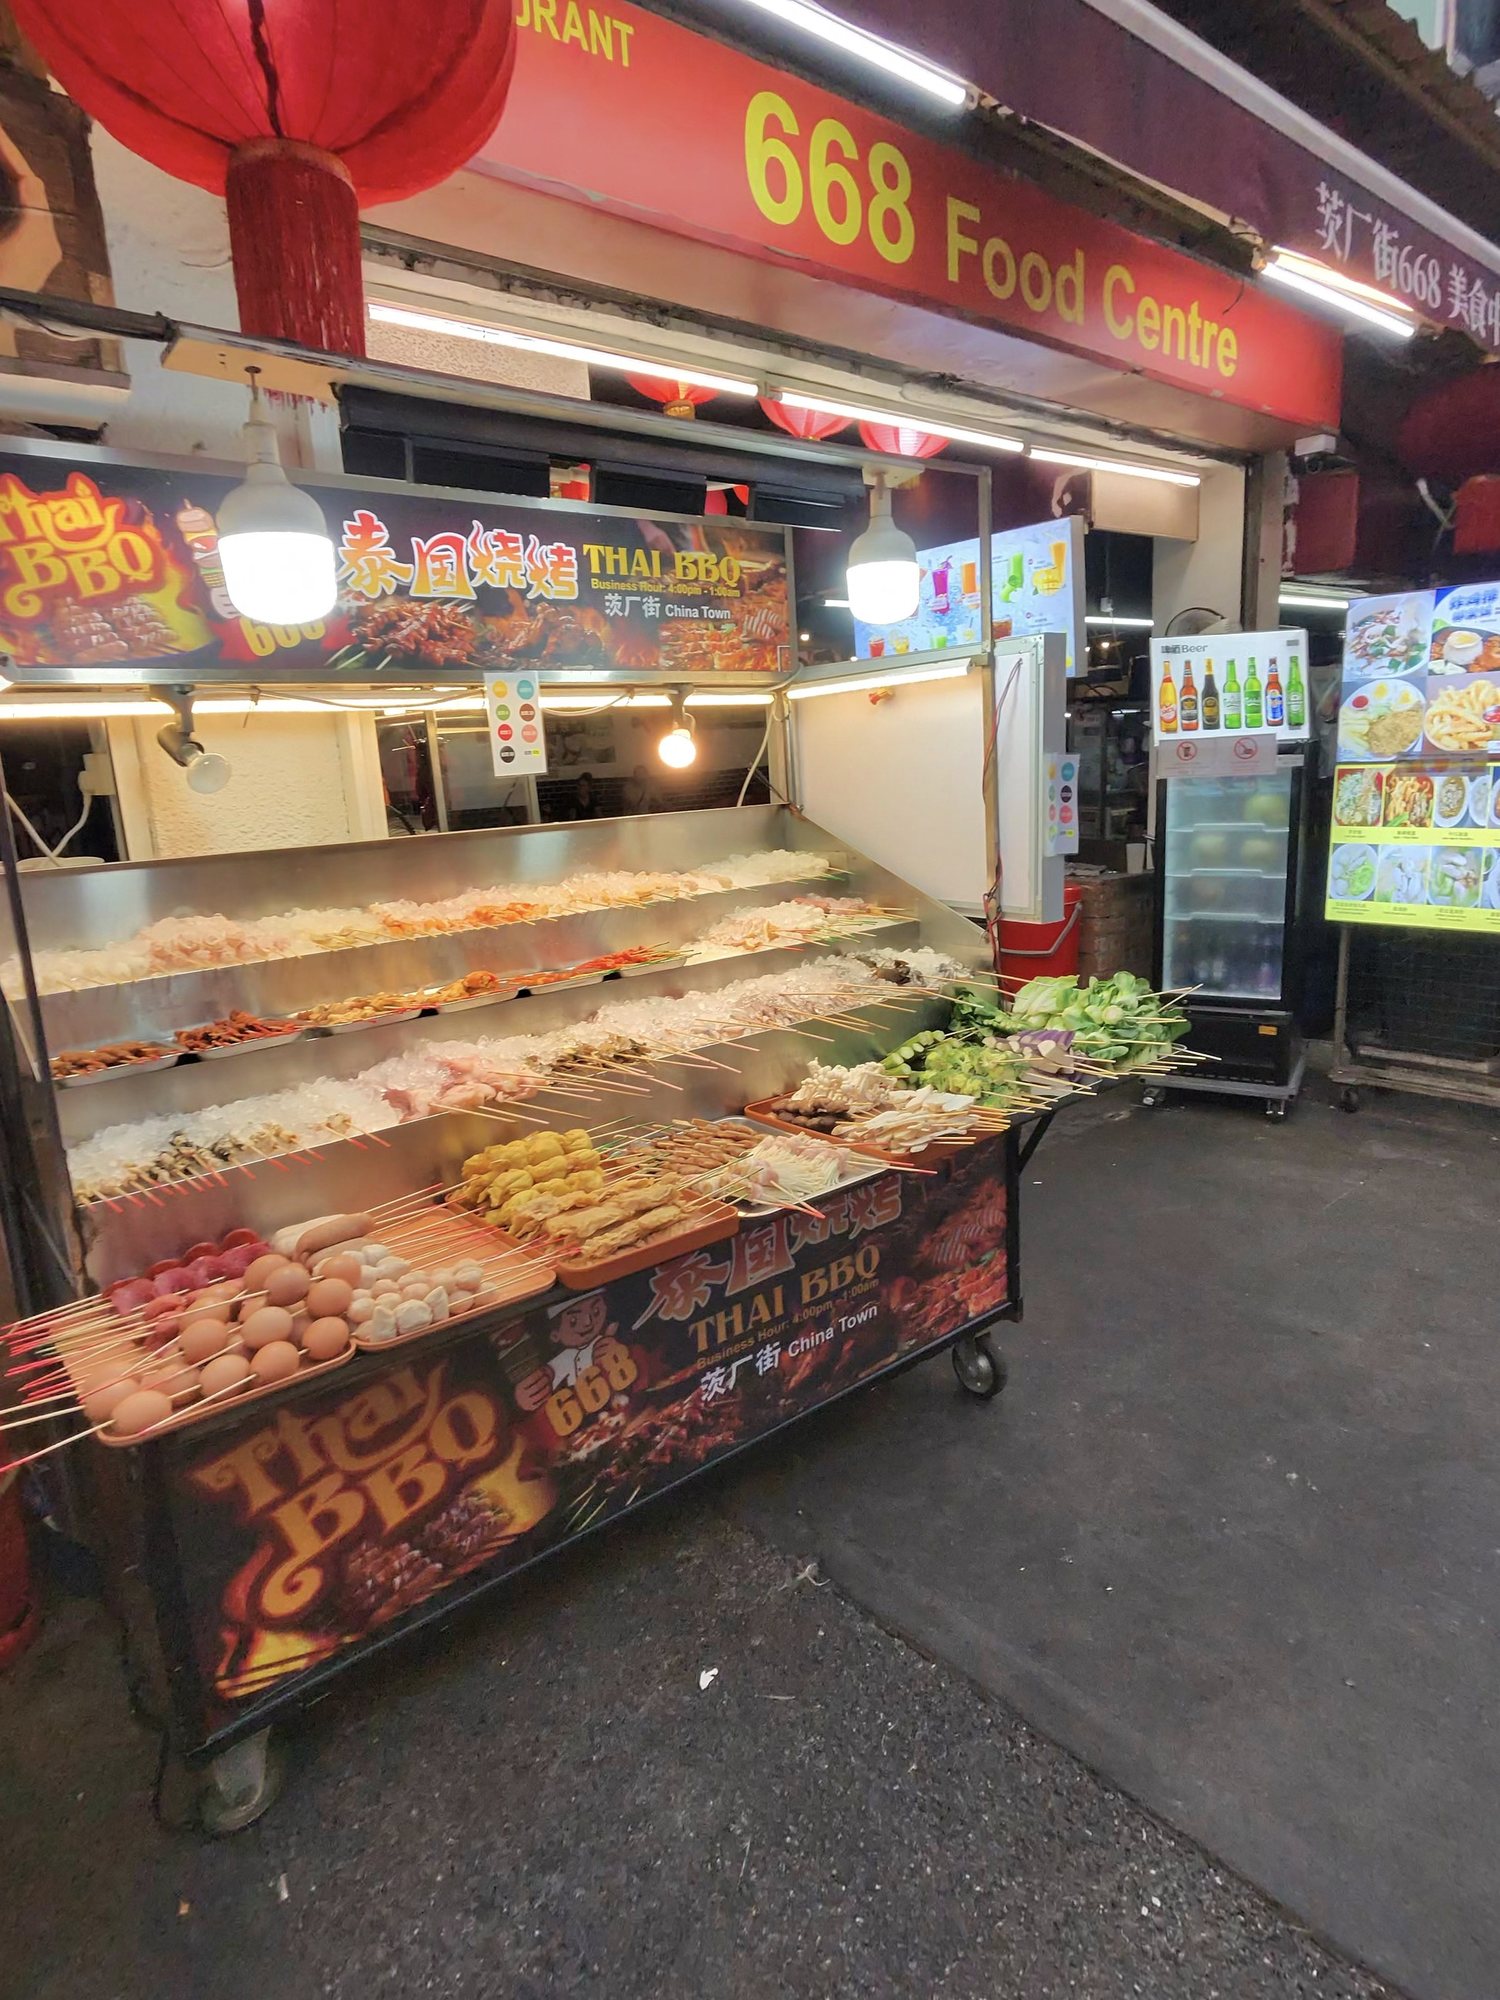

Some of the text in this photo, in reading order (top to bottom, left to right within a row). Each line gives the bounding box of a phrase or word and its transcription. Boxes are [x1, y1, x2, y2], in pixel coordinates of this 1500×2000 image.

[744, 91, 1237, 377] 668 Food Centre
[4, 531, 154, 618] BBQ
[337, 510, 579, 599] 泰国烧烤
[583, 543, 742, 588] THAI BBQ
[591, 578, 638, 592] Business
[639, 581, 666, 593] Hour:
[604, 592, 731, 619] 茨厂街 China Town
[1181, 644, 1209, 654] Beer
[688, 1244, 881, 1353] THAI BBQ
[696, 1338, 755, 1370] Business
[758, 1320, 790, 1343] Hour:
[701, 1305, 878, 1402] 茨厂街 China Town
[545, 1343, 638, 1437] 668
[261, 1391, 498, 1618] BBQ
